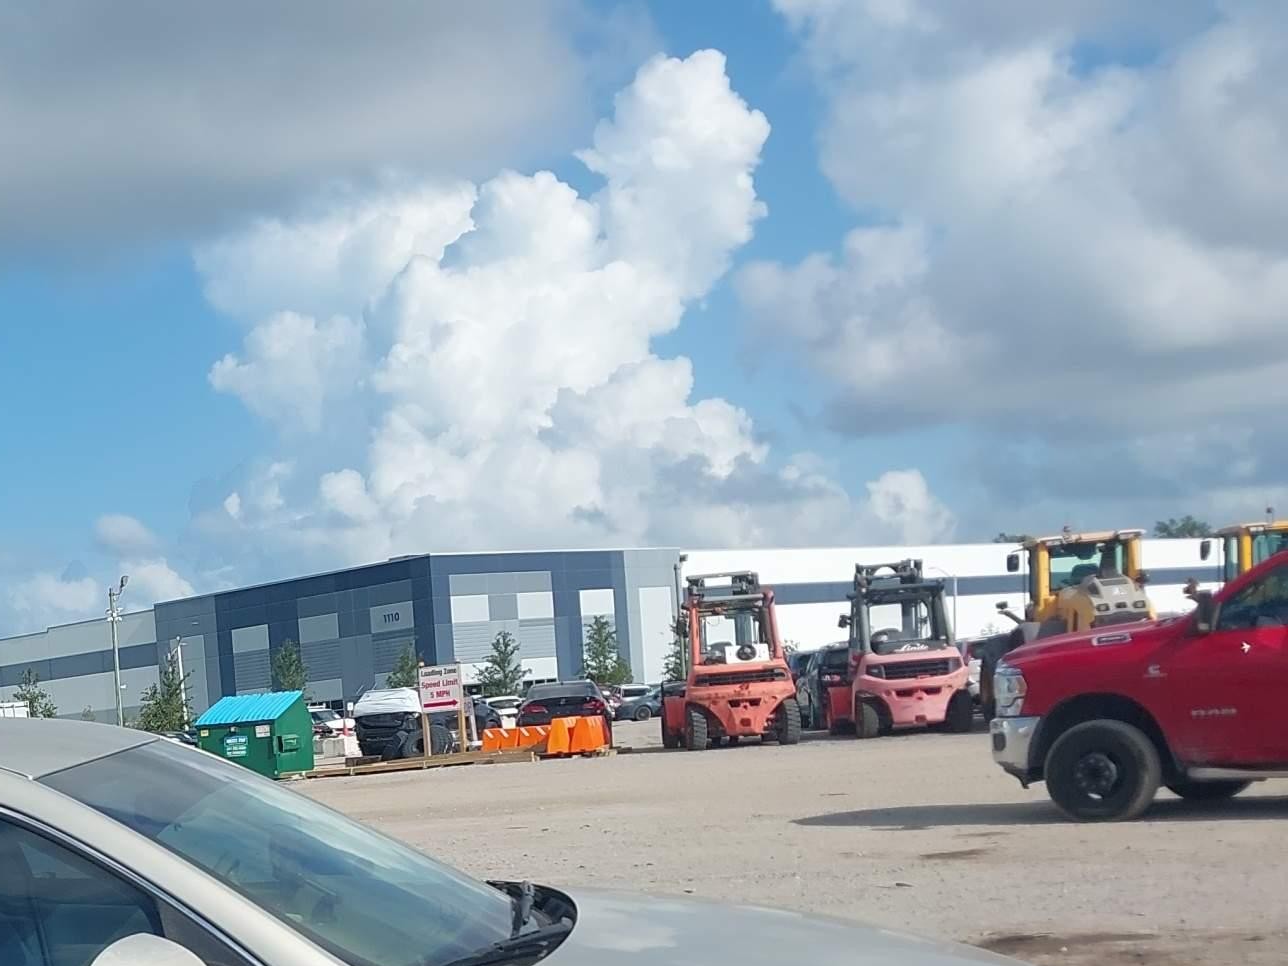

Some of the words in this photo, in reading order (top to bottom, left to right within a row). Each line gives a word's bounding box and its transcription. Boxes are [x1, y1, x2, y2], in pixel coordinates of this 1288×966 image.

[383, 611, 400, 624] 1110
[420, 669, 443, 677] Loading
[443, 667, 457, 675] Zone
[421, 681, 441, 689] Speed
[442, 678, 458, 687] Limit
[436, 690, 450, 698] MPH
